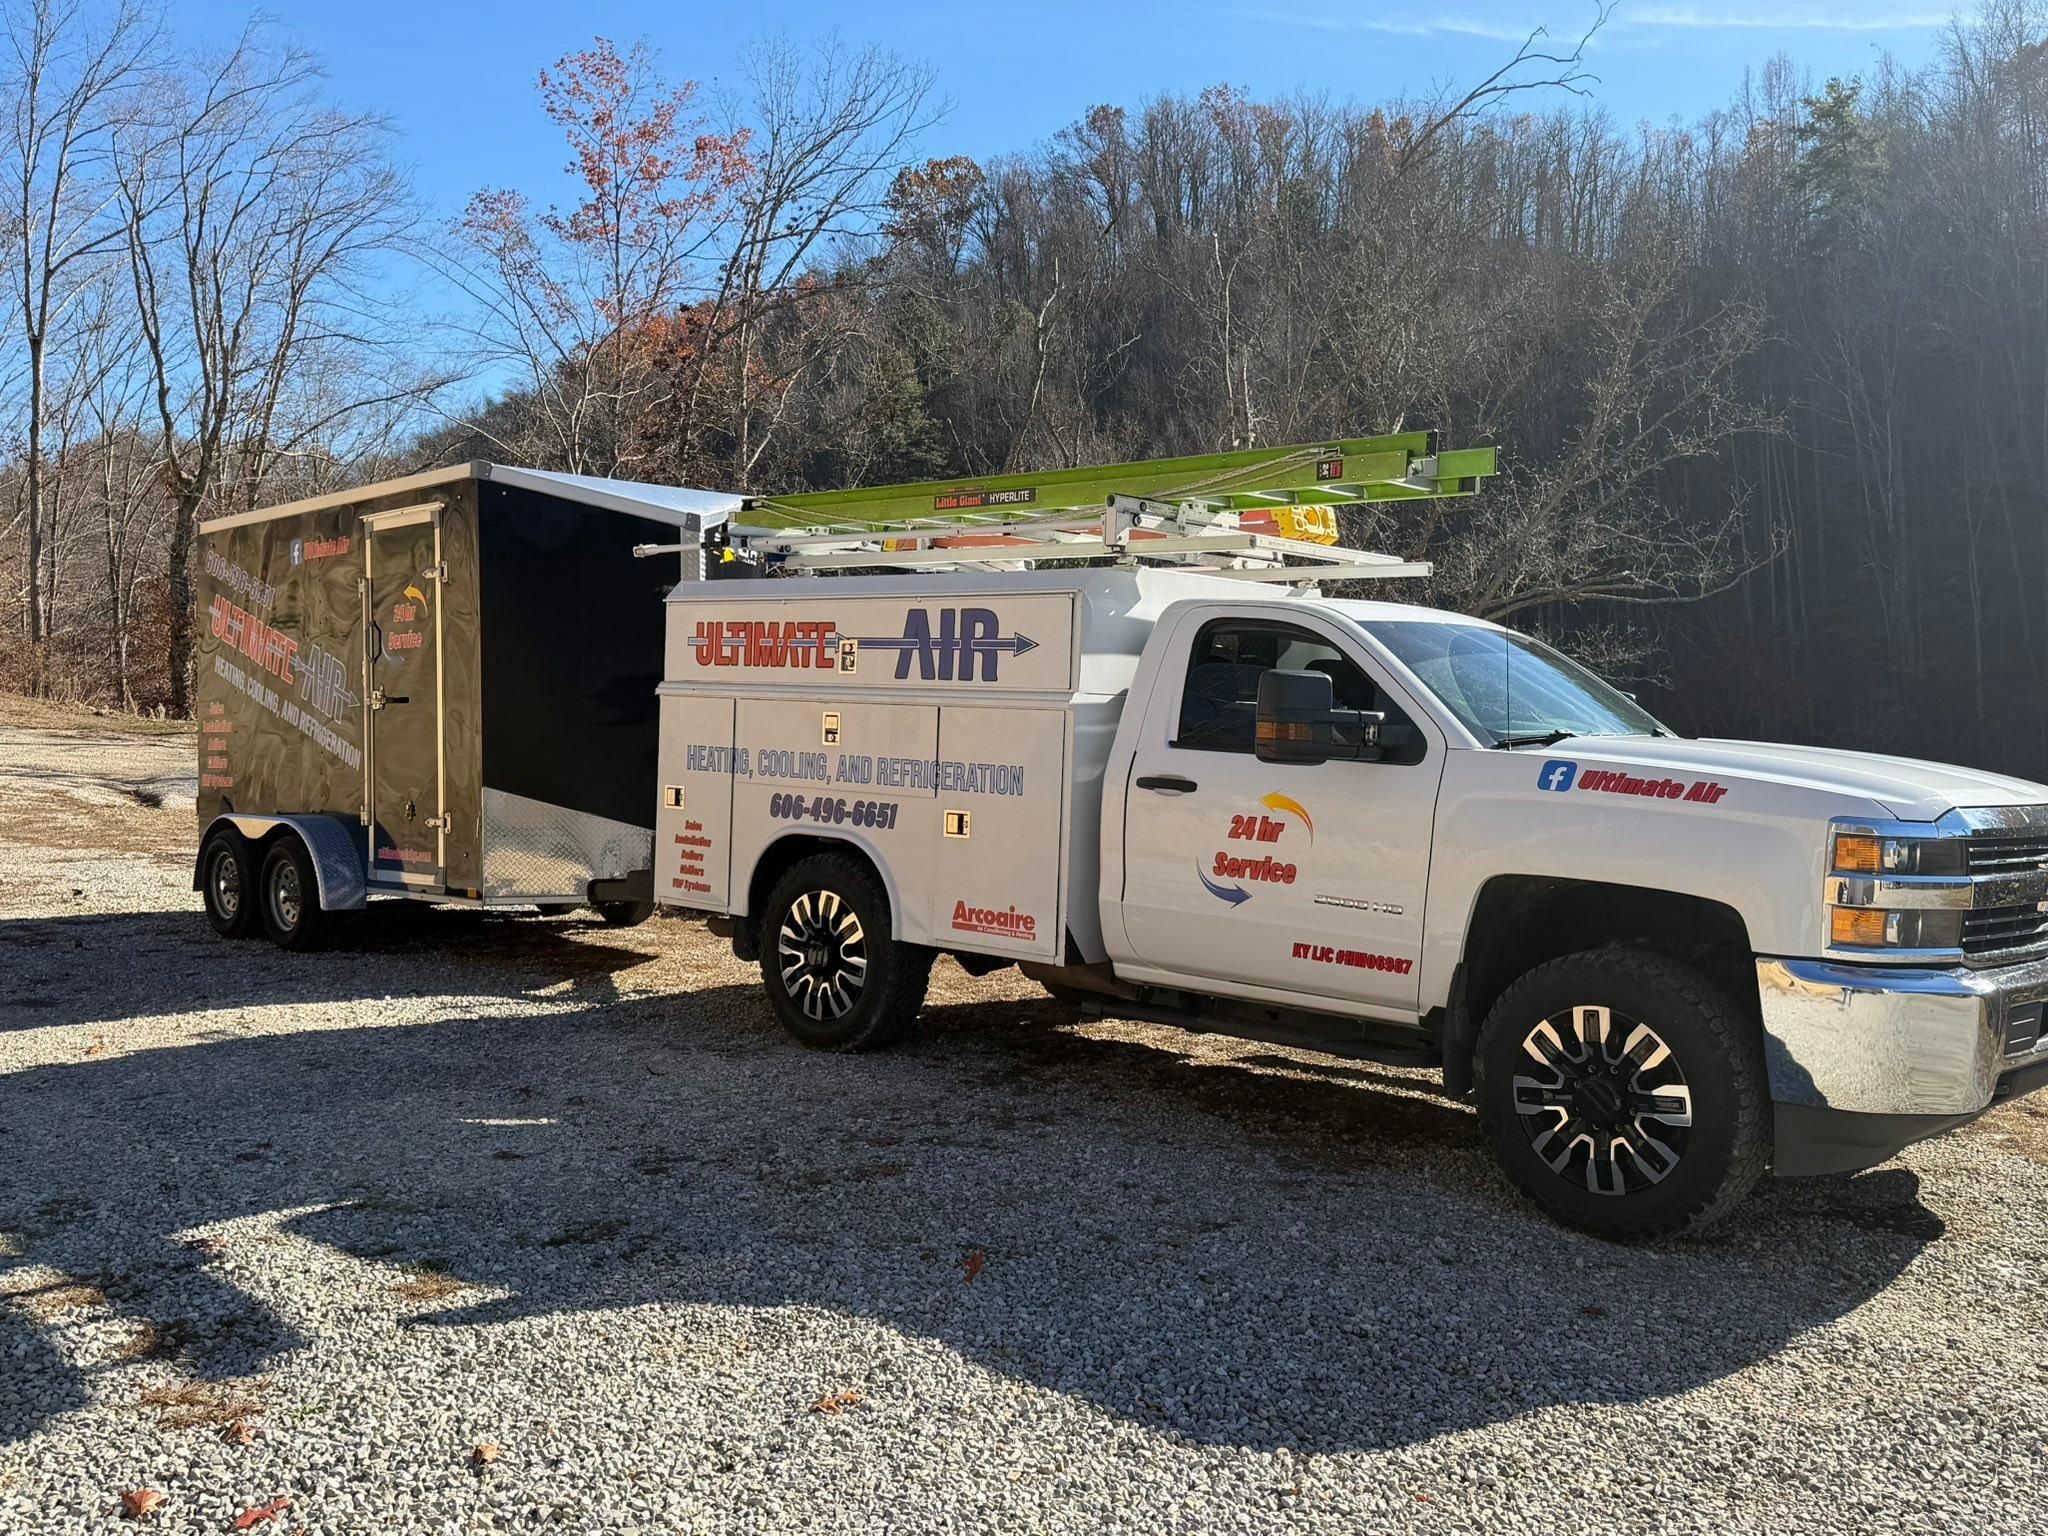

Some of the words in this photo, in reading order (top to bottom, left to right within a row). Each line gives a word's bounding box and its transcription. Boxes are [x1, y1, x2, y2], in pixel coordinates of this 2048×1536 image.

[936, 496, 958, 508] Little
[960, 495, 982, 507] Giant
[989, 490, 1030, 504] HYPERLITE
[393, 604, 404, 622] 24
[388, 629, 422, 649] Service
[695, 621, 836, 668] ULTIMATE
[894, 608, 999, 682] AIR
[211, 594, 298, 685] ULTIMATE
[301, 644, 347, 725] AIR
[214, 654, 246, 694] HEATING,
[247, 676, 280, 718] COOLING,
[281, 700, 300, 727] AND
[299, 711, 361, 771] REFRIGERATION
[687, 745, 753, 779] HEATING,
[758, 749, 832, 785] COOLING,
[836, 755, 873, 784] AND
[877, 757, 1024, 796] REFRIGERATION
[1578, 770, 1685, 800] Ultimate
[1683, 781, 1728, 804] Air
[770, 792, 899, 829] 606-496-6651
[674, 834, 712, 847] Installation
[1228, 815, 1258, 841] 24
[1257, 816, 1285, 843] hr
[1213, 852, 1297, 884] Service
[952, 900, 1036, 931] Arcoaire
[1292, 942, 1311, 959] KY
[1311, 945, 1335, 963] LIC
